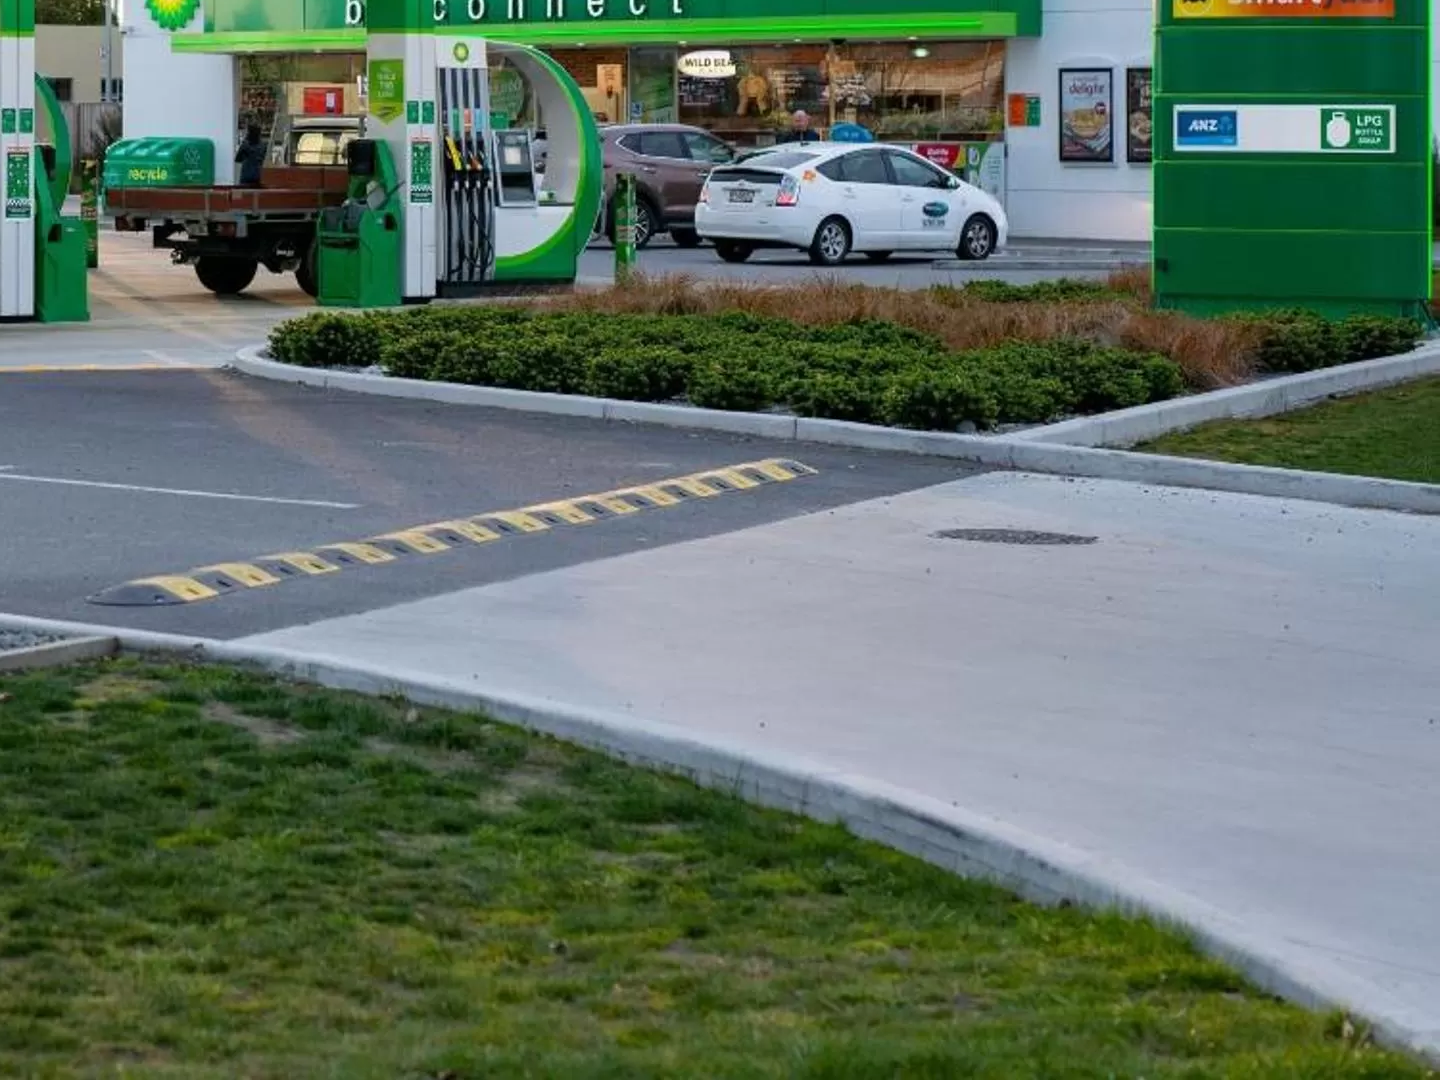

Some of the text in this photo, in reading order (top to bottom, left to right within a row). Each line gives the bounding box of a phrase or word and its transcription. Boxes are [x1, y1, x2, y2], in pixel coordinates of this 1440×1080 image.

[685, 58, 711, 67] WILD
[1188, 119, 1218, 132] ANZ
[1357, 115, 1383, 127] LPG
[128, 167, 168, 184] recycle
